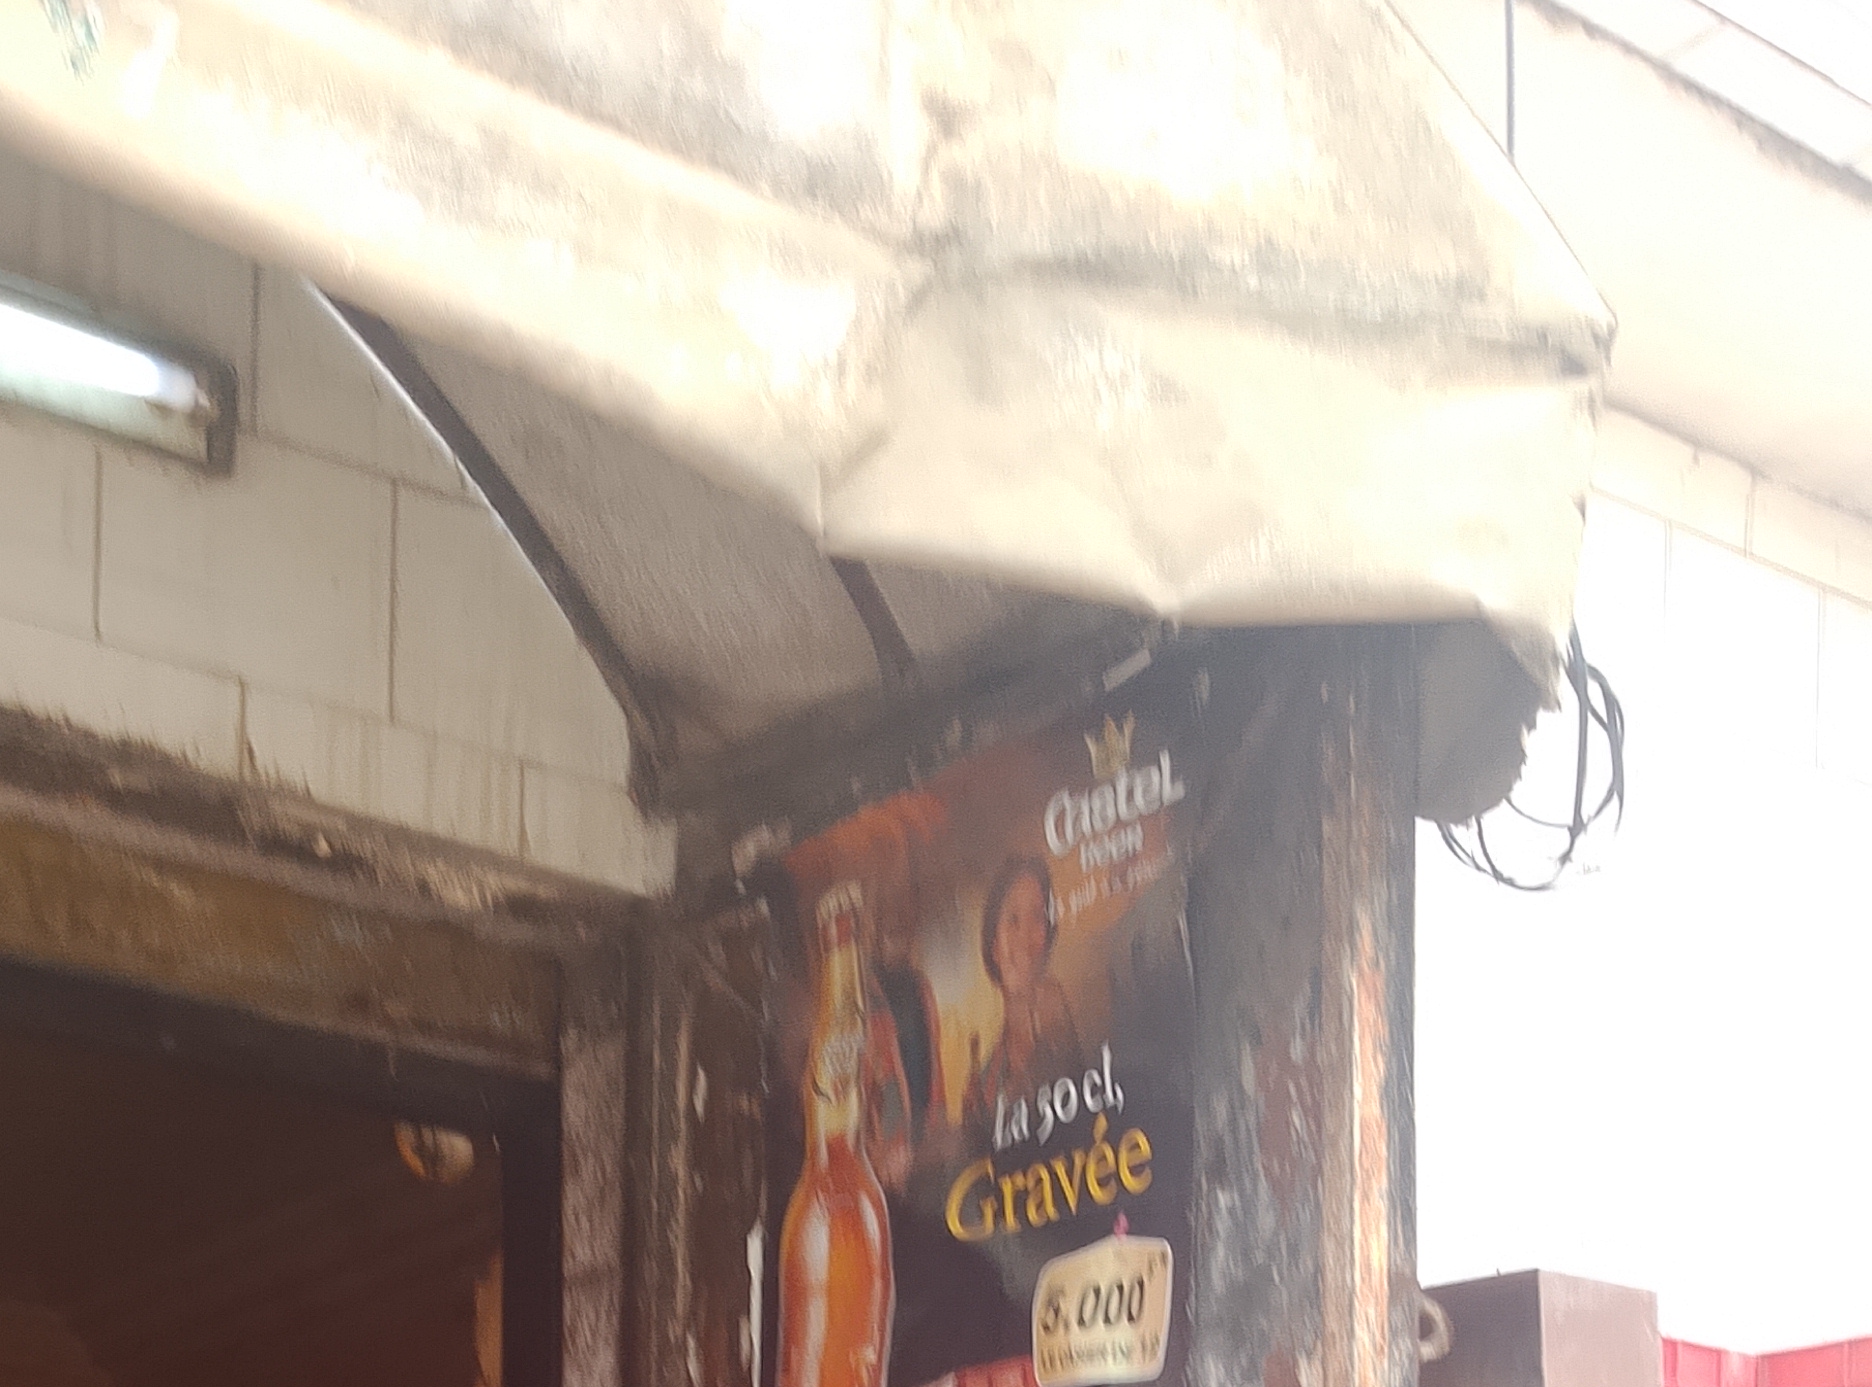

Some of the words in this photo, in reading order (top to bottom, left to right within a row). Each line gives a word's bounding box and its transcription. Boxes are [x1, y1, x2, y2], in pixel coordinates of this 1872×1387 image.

[1036, 1076, 1078, 1146] 50
[945, 1111, 1152, 1242] Gravée
[1039, 1275, 1145, 1335] 5.000
